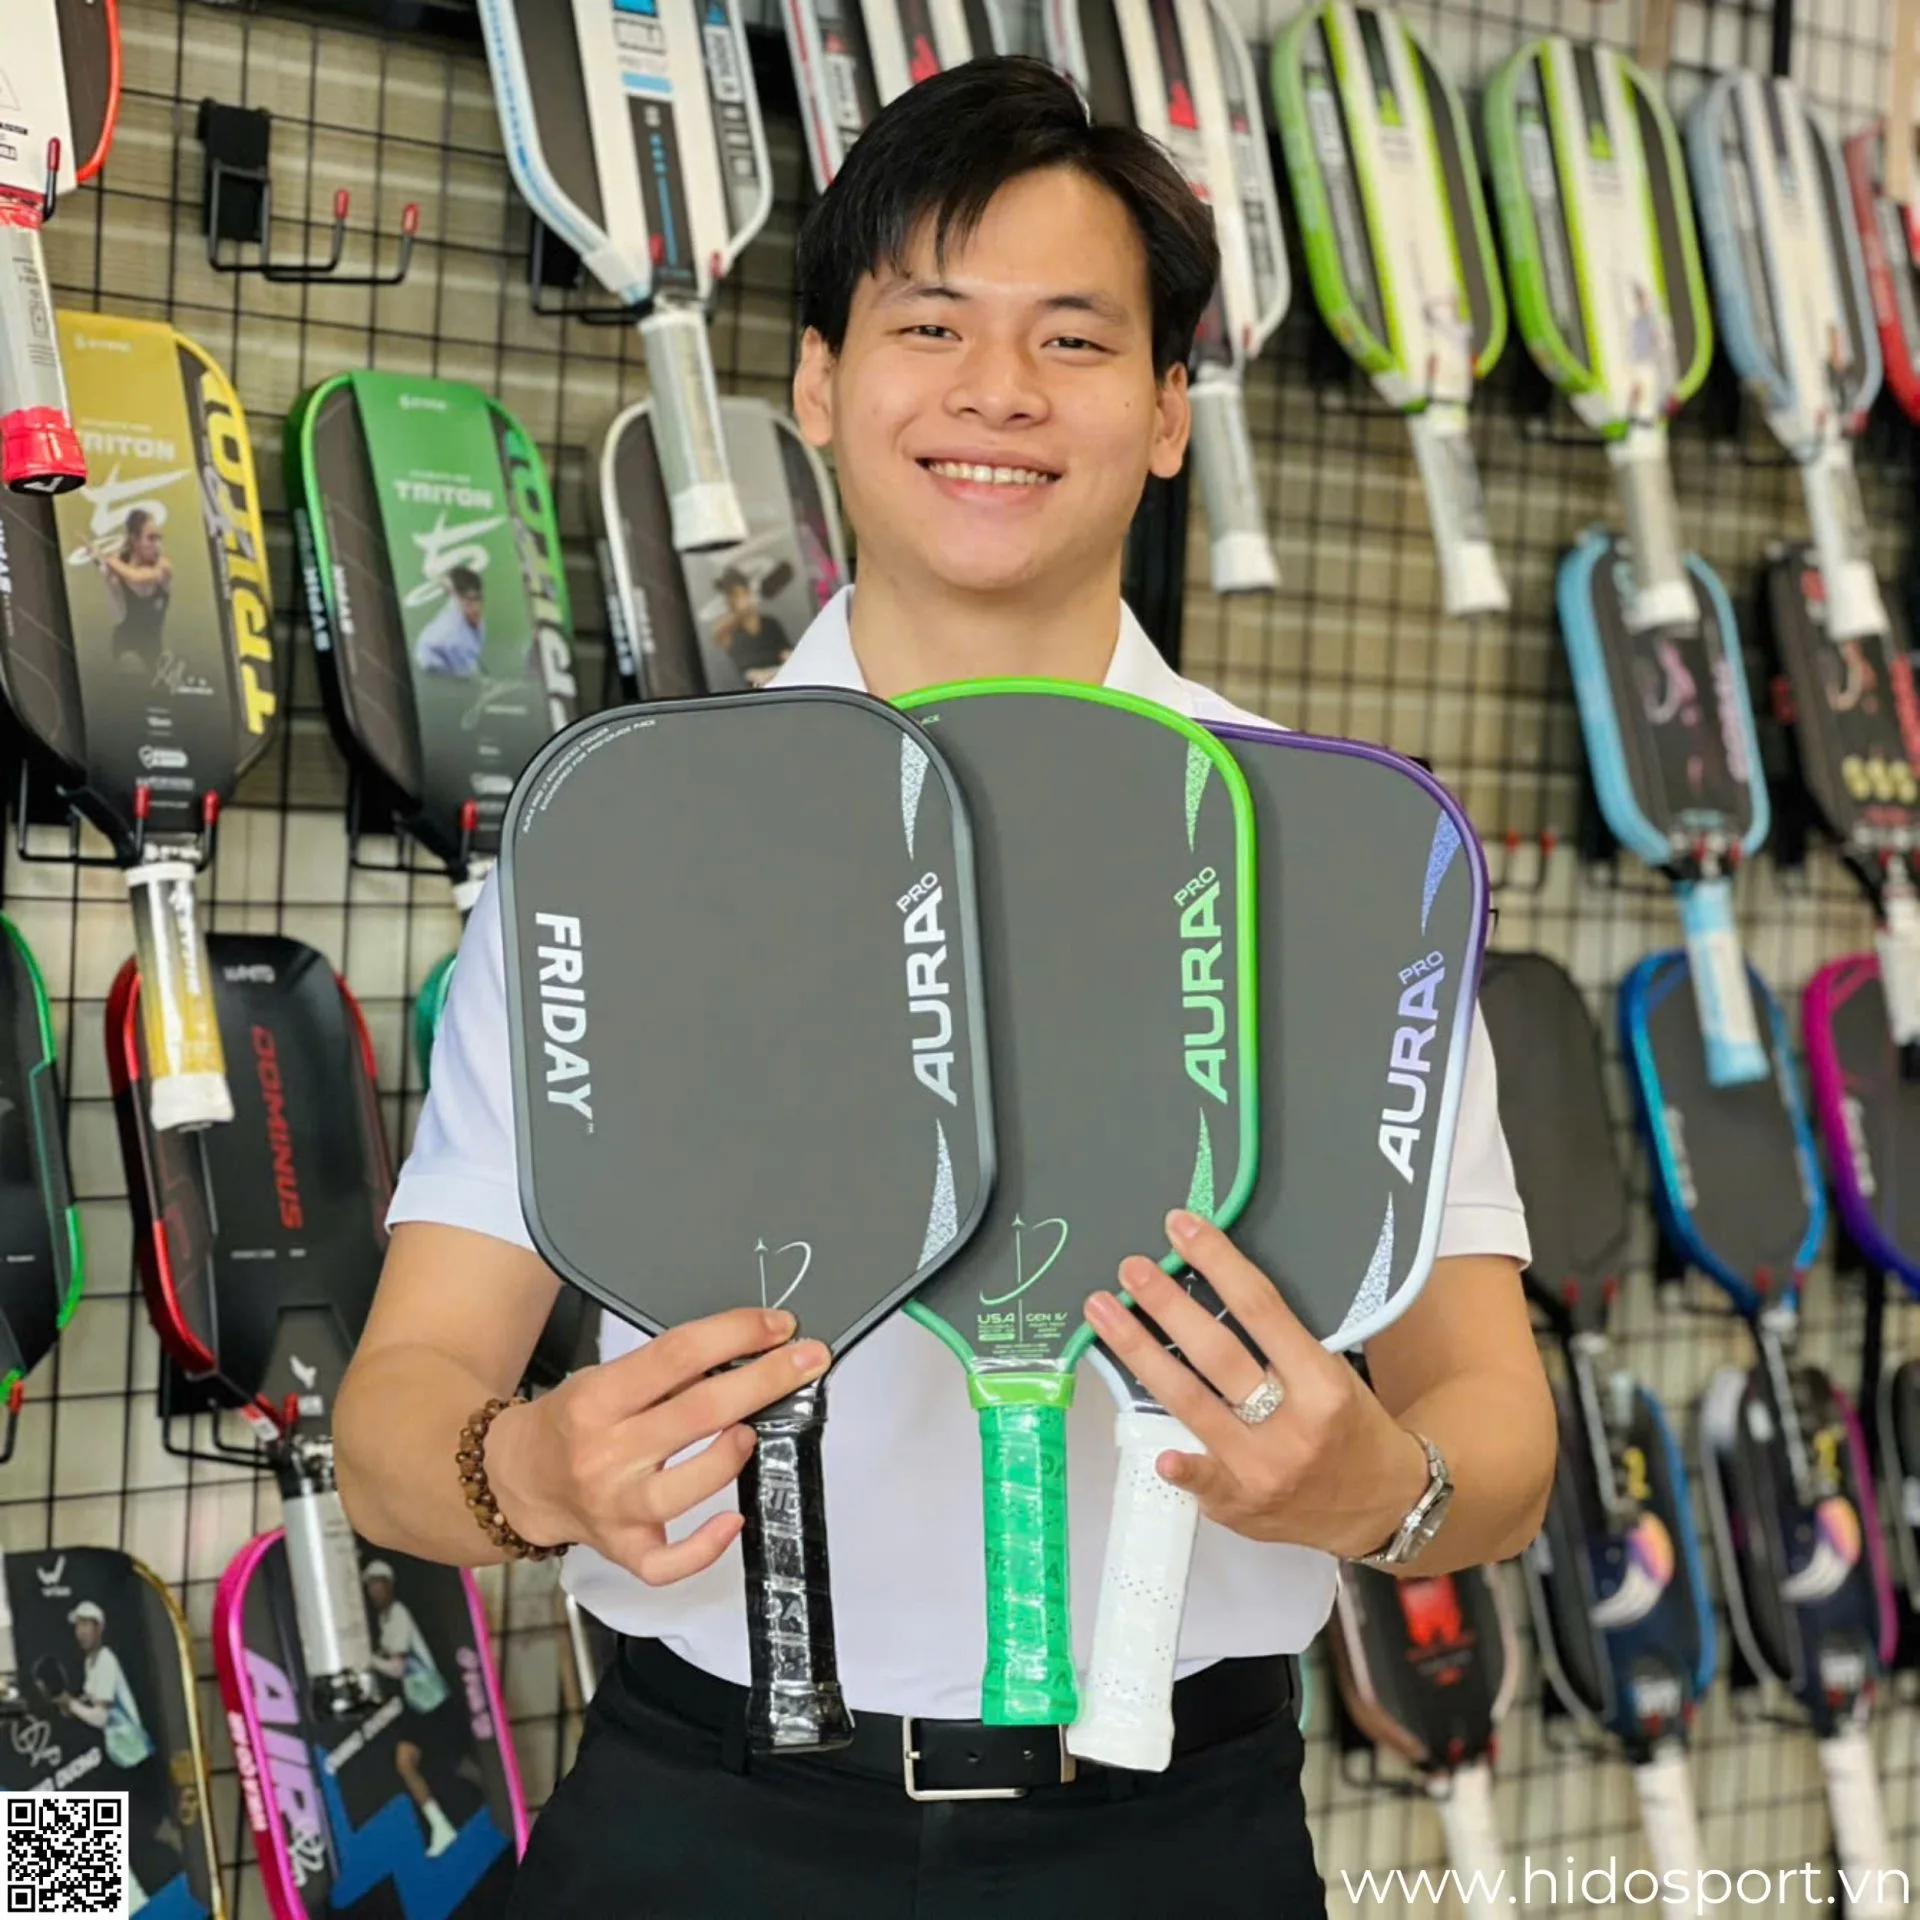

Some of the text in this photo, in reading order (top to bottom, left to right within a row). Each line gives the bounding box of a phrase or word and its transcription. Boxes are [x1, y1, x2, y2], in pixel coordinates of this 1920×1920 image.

[896, 871, 939, 914] PRO
[1173, 866, 1217, 907] PRO
[1398, 950, 1445, 984] PRO
[535, 912, 593, 1120] FRIDAY
[904, 885, 958, 1107] AURA
[1180, 880, 1229, 1104] AURA
[1378, 966, 1446, 1184] AURA
[251, 1024, 304, 1229] DOMINUS
[977, 1312, 1016, 1324] USA
